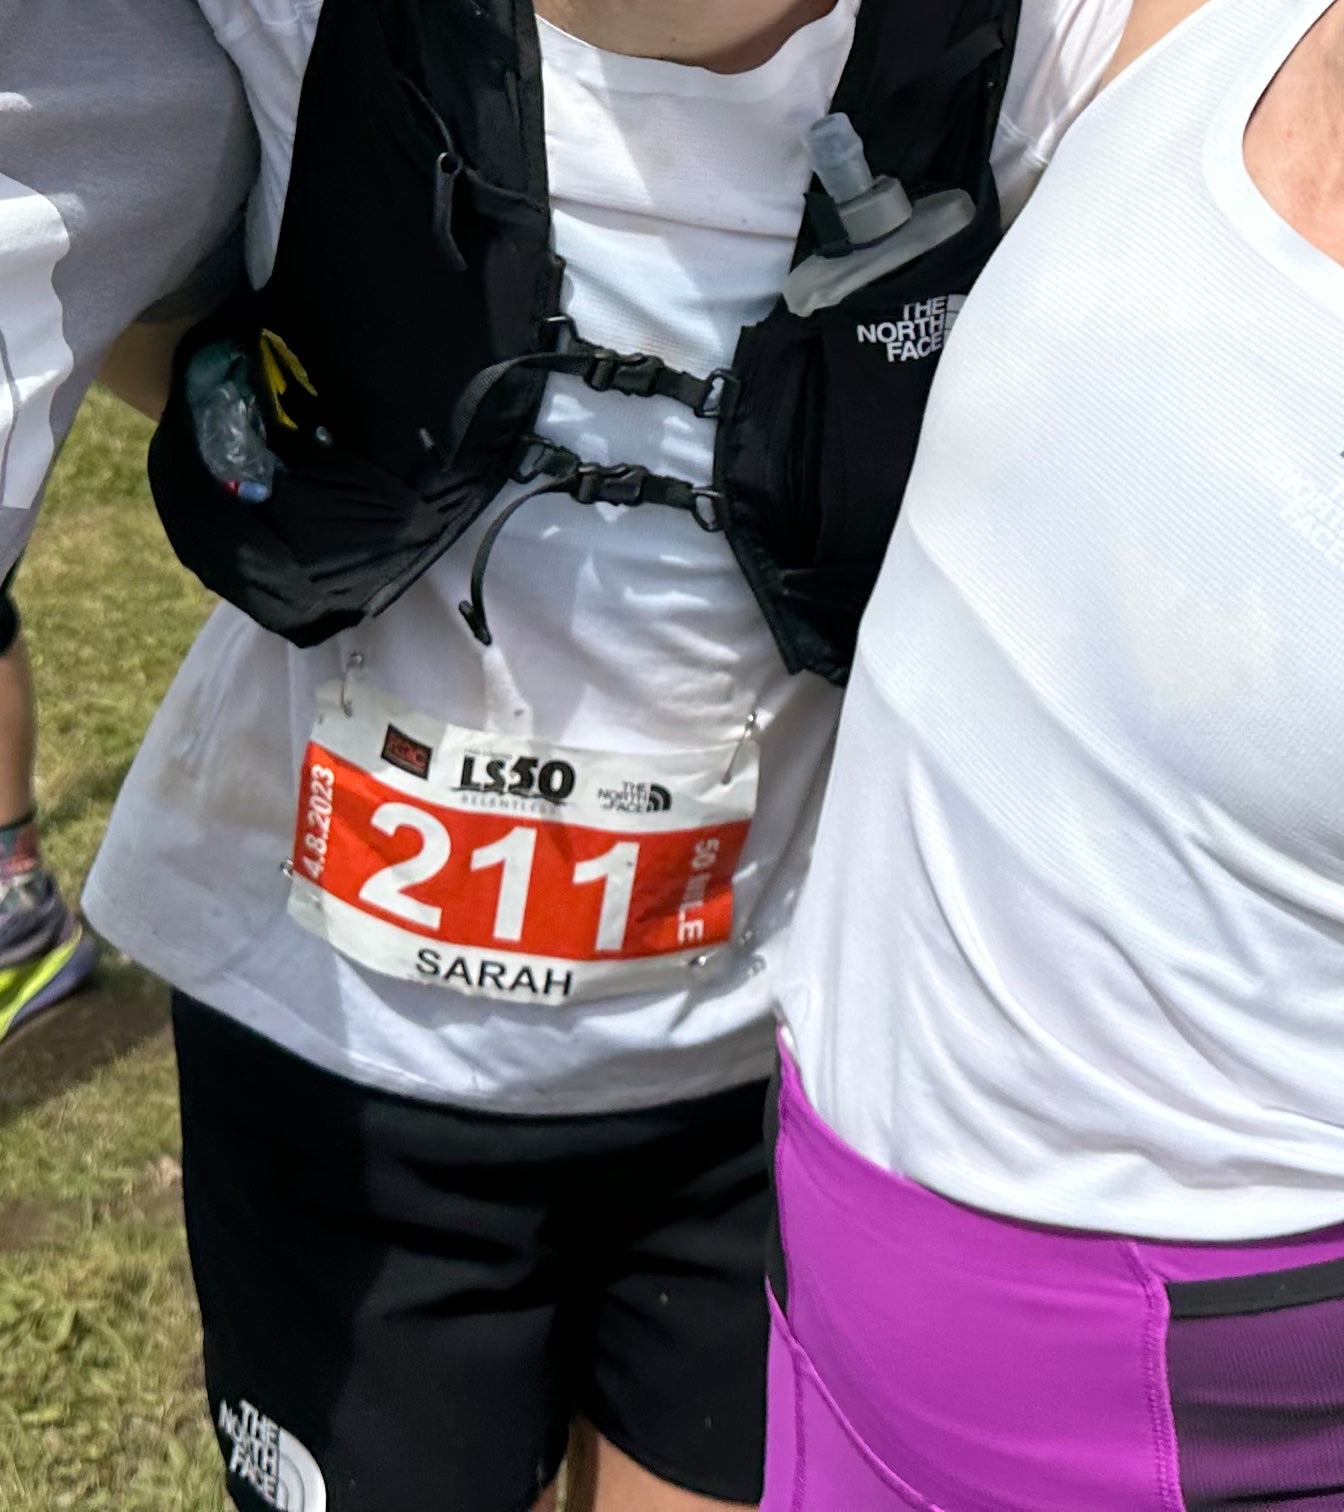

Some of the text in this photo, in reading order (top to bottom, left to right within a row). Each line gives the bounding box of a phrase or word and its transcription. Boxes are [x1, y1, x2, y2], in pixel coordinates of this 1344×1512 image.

[857, 314, 945, 344] NORTH
[903, 296, 947, 321] THE
[886, 332, 944, 363] FACE
[460, 755, 577, 801] LS50
[302, 764, 335, 878] 4.8.2023
[358, 802, 640, 952] 211
[415, 947, 574, 997] SARAH
